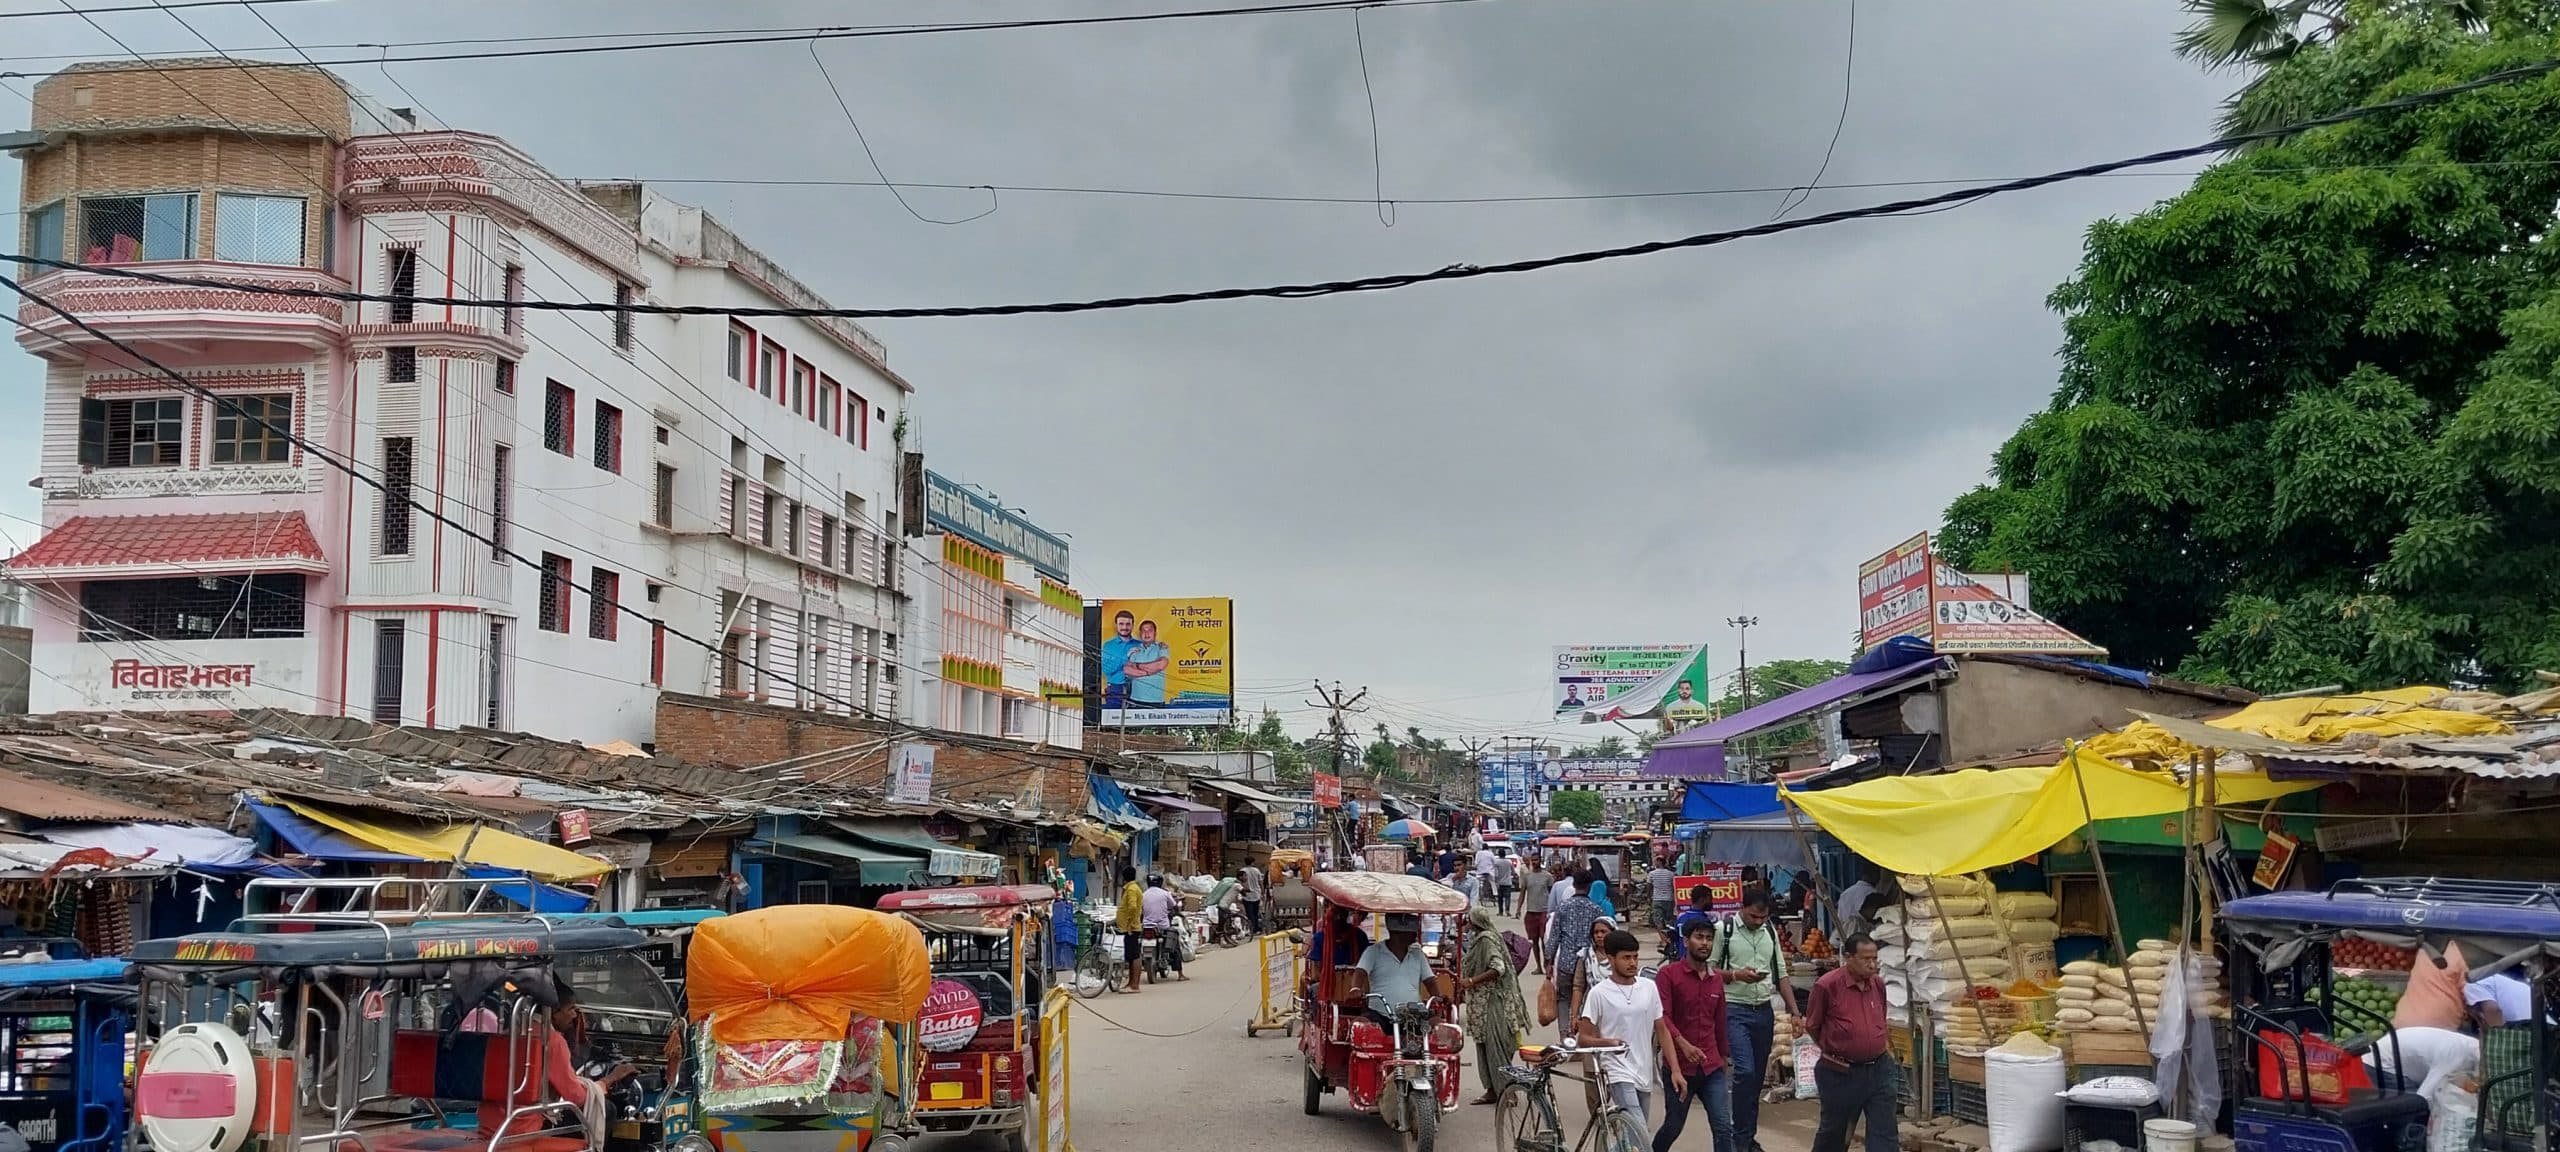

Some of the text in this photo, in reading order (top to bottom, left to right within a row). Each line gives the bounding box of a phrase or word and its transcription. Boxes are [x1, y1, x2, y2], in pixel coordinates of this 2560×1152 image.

[1878, 560, 1901, 590] WATCH
[1902, 548, 1924, 579] PLACE
[1171, 607, 1184, 617] मेरा
[1180, 618, 1222, 629] मेरा भरोसा
[1557, 653, 1606, 670] gravity
[111, 659, 255, 689] विवाह भवन
[1586, 686, 1605, 695] 375
[1587, 694, 1605, 702] AIR
[175, 940, 211, 960] Mini
[417, 936, 539, 959] Mini Metro
[920, 1014, 974, 1034] Bata
[17, 1108, 57, 1141] SAARTHI
